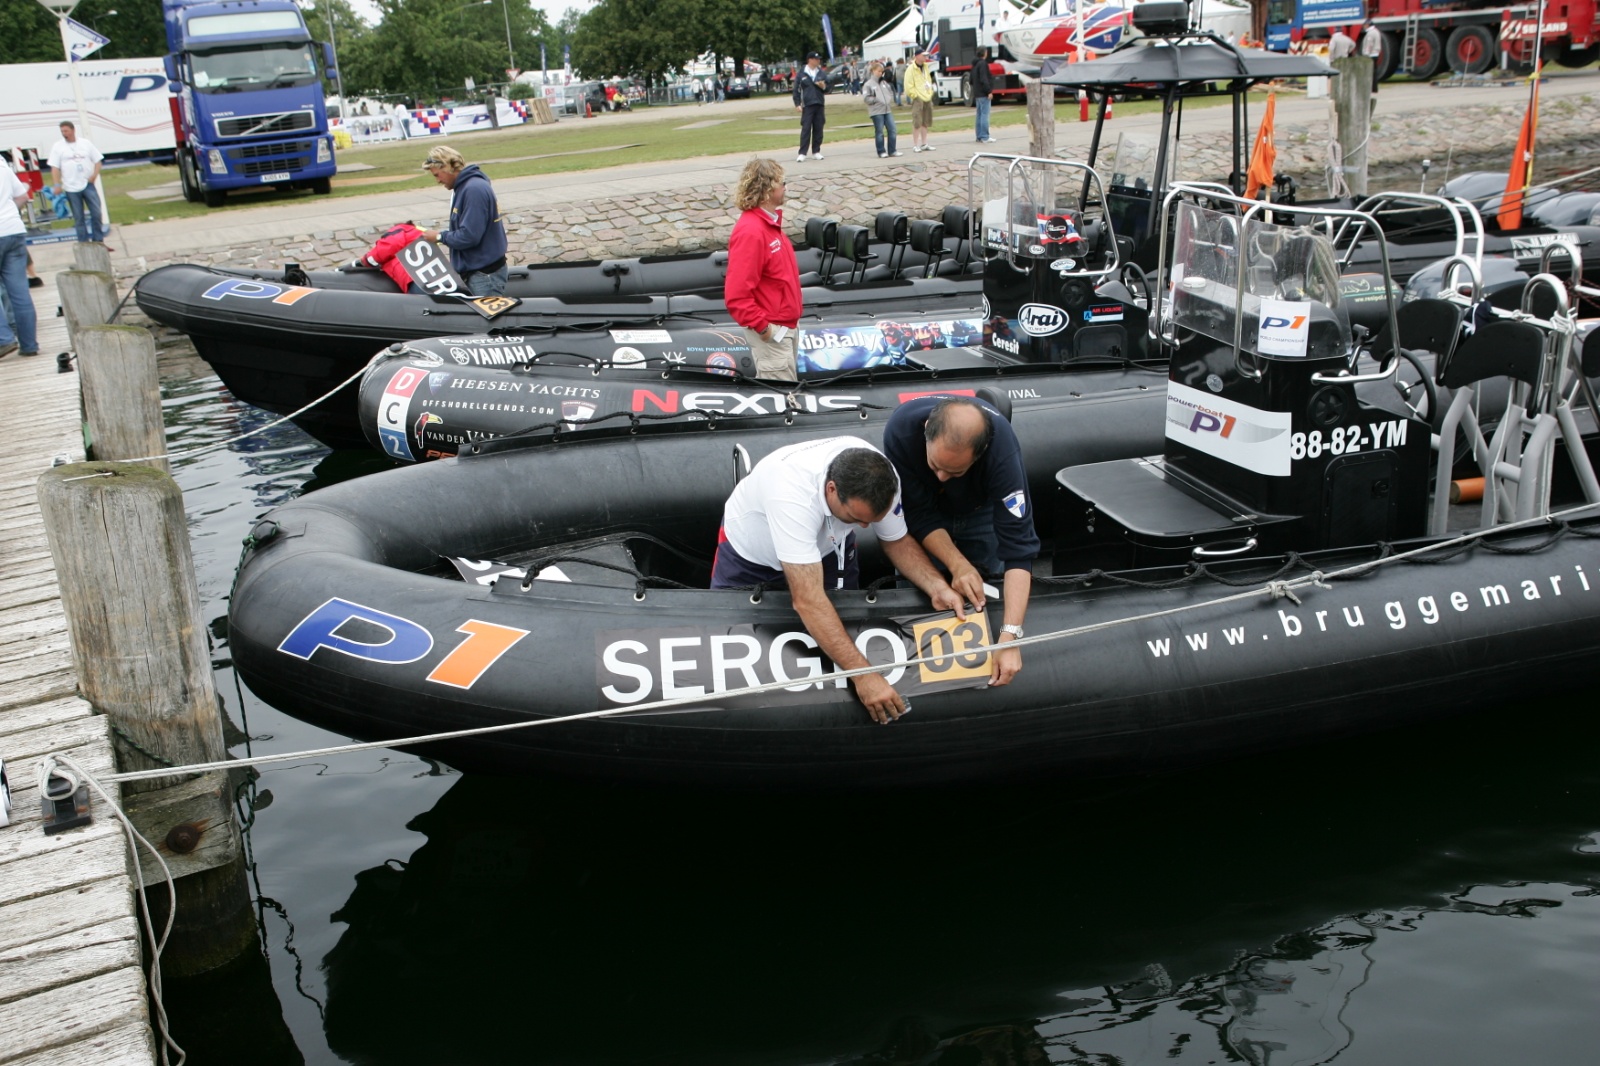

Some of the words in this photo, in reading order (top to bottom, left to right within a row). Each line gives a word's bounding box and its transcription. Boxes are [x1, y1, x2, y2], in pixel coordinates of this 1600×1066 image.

[201, 278, 319, 306] P1
[1022, 307, 1060, 327] Arai
[1261, 315, 1306, 329] P1
[467, 345, 540, 365] YAMAHA
[992, 332, 1020, 355] Ceresit
[394, 372, 414, 391] D
[450, 378, 522, 392] HEESEN
[528, 383, 601, 399] YACHTS
[386, 401, 401, 425] C
[422, 399, 555, 415] OFFSHORELEGENDS.COM
[1167, 394, 1225, 418] powerboat
[1189, 411, 1237, 440] P1
[388, 436, 406, 456] 2
[427, 431, 444, 442] VAN
[446, 434, 465, 445] DER
[1291, 419, 1408, 461] 88-82-YM
[1147, 564, 1600, 658] www.bruggemari
[276, 596, 531, 690] P1
[919, 621, 988, 674] 03
